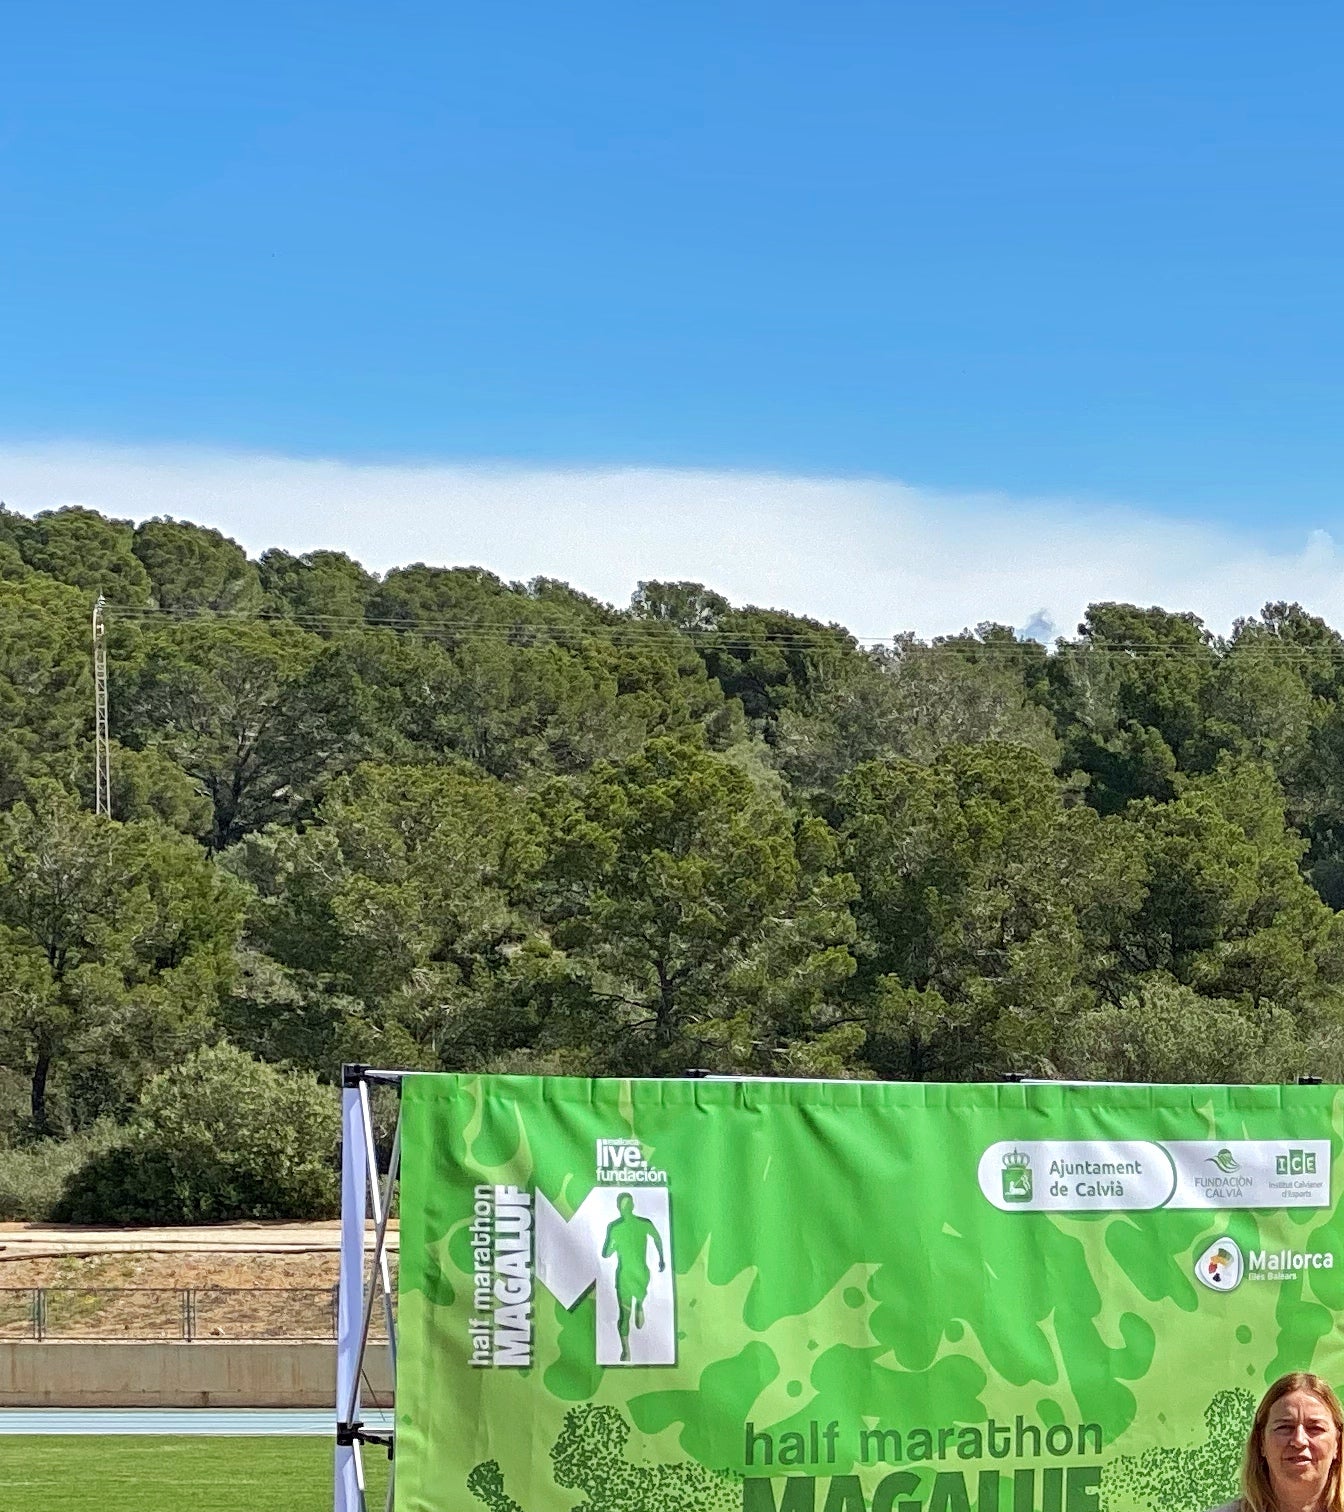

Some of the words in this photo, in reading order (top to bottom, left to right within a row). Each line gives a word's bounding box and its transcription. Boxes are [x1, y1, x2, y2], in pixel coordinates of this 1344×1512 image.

[596, 1167, 667, 1182] fundación
[1049, 1160, 1142, 1176] Ajuntament
[1278, 1156, 1315, 1173] ICE
[1050, 1182, 1068, 1197] de
[1076, 1180, 1124, 1197] Calvià
[469, 1185, 492, 1313] marathon
[1249, 1249, 1334, 1271] Mallorca
[493, 1184, 532, 1367] MAGALUF
[468, 1317, 490, 1366] half
[744, 1420, 840, 1466] half
[859, 1415, 1103, 1463] marathon
